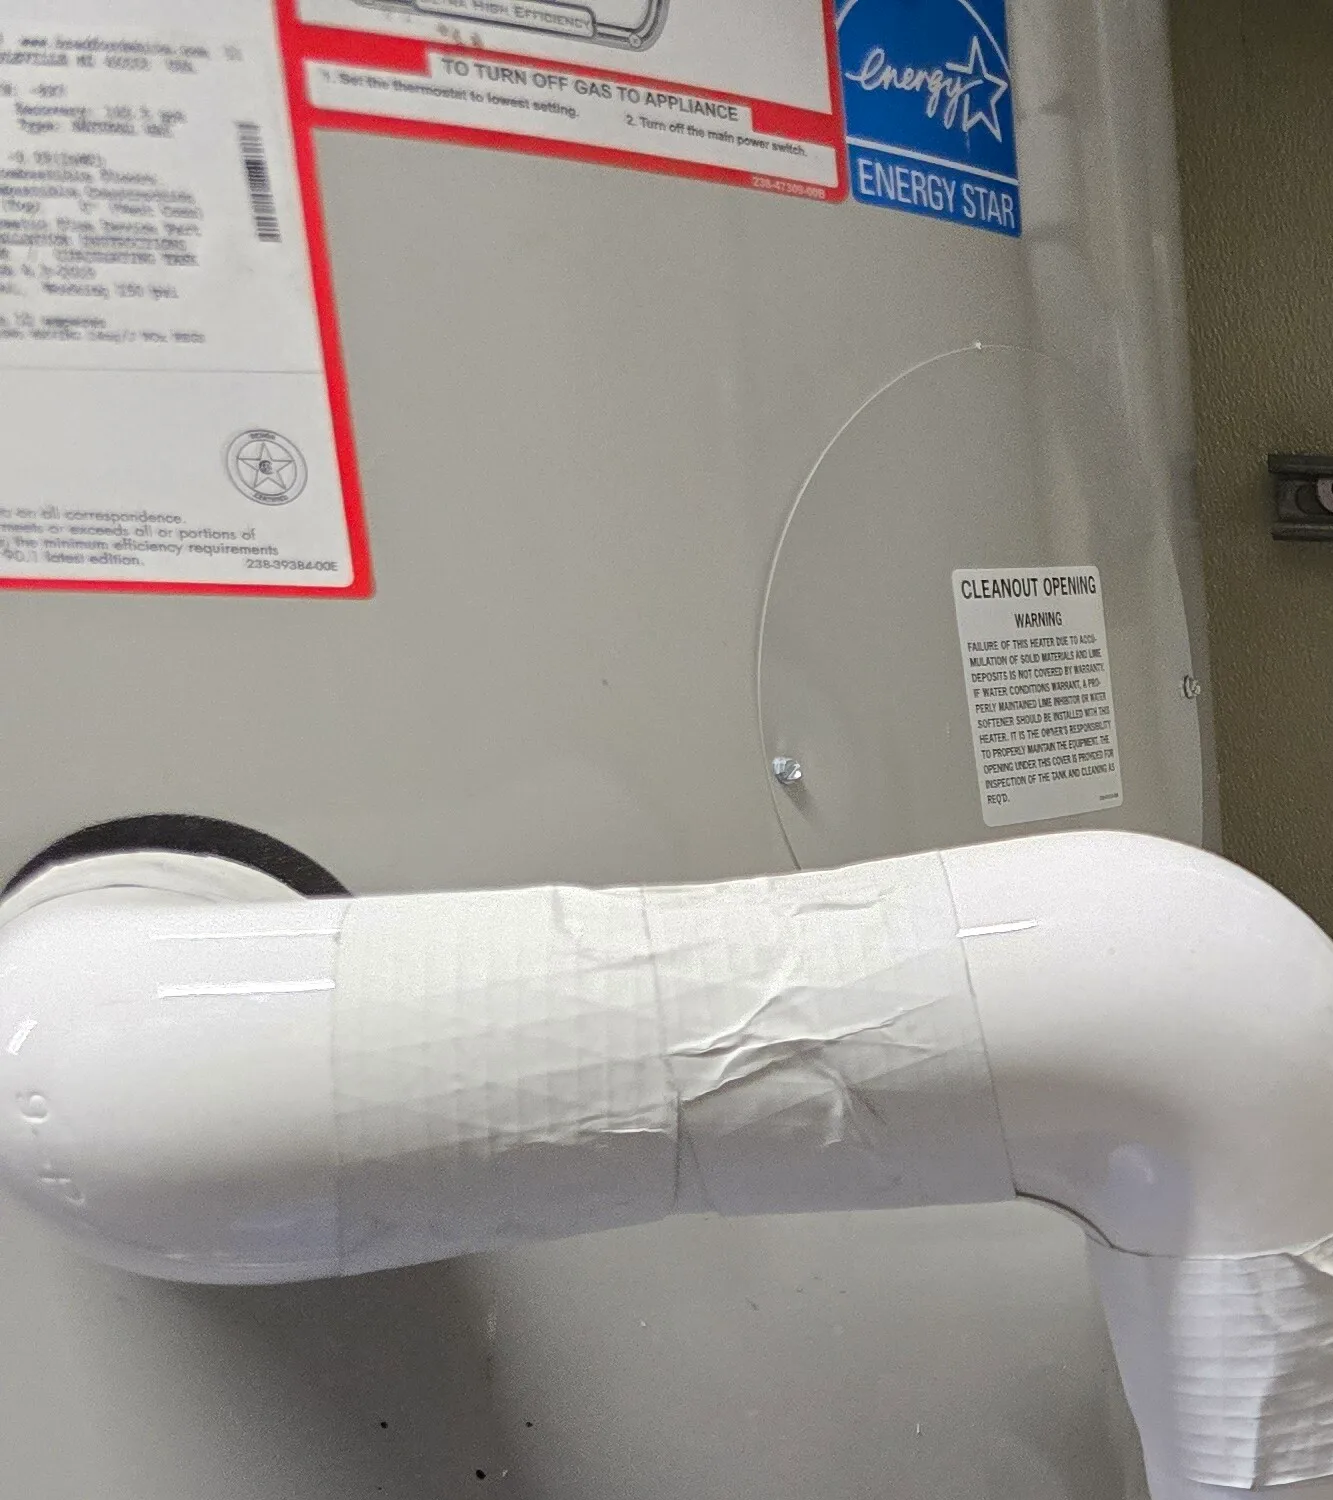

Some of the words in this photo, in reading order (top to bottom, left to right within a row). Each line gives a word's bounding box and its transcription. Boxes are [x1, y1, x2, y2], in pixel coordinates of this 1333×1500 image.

[442, 57, 470, 76] TO
[474, 63, 527, 86] TURN
[532, 73, 568, 92] OFF
[574, 79, 612, 99] GAS
[617, 86, 640, 104] TO
[645, 92, 739, 121] APPLIANCE
[846, 48, 982, 129] energy
[639, 117, 667, 131] Turn
[669, 122, 684, 134] off
[687, 125, 704, 138] the
[708, 129, 734, 145] main
[737, 135, 769, 151] power
[772, 142, 807, 157] switch.
[858, 158, 956, 212] ENERGY
[962, 183, 1015, 228] STAR
[961, 578, 1038, 599] CLEANOUT
[1044, 576, 1096, 596] OPENING
[1014, 612, 1062, 628] WARNING
[968, 640, 999, 652] FAILURE
[1001, 641, 1010, 650] OF
[1013, 639, 1028, 649] THIS
[1030, 638, 1055, 648] HEATER
[1057, 637, 1068, 646] DUE
[1070, 636, 1078, 645] TO
[970, 656, 1007, 667] MULATION
[1009, 654, 1018, 664] OF
[1020, 653, 1040, 664] SOLID
[1042, 651, 1074, 662] MATERIALS
